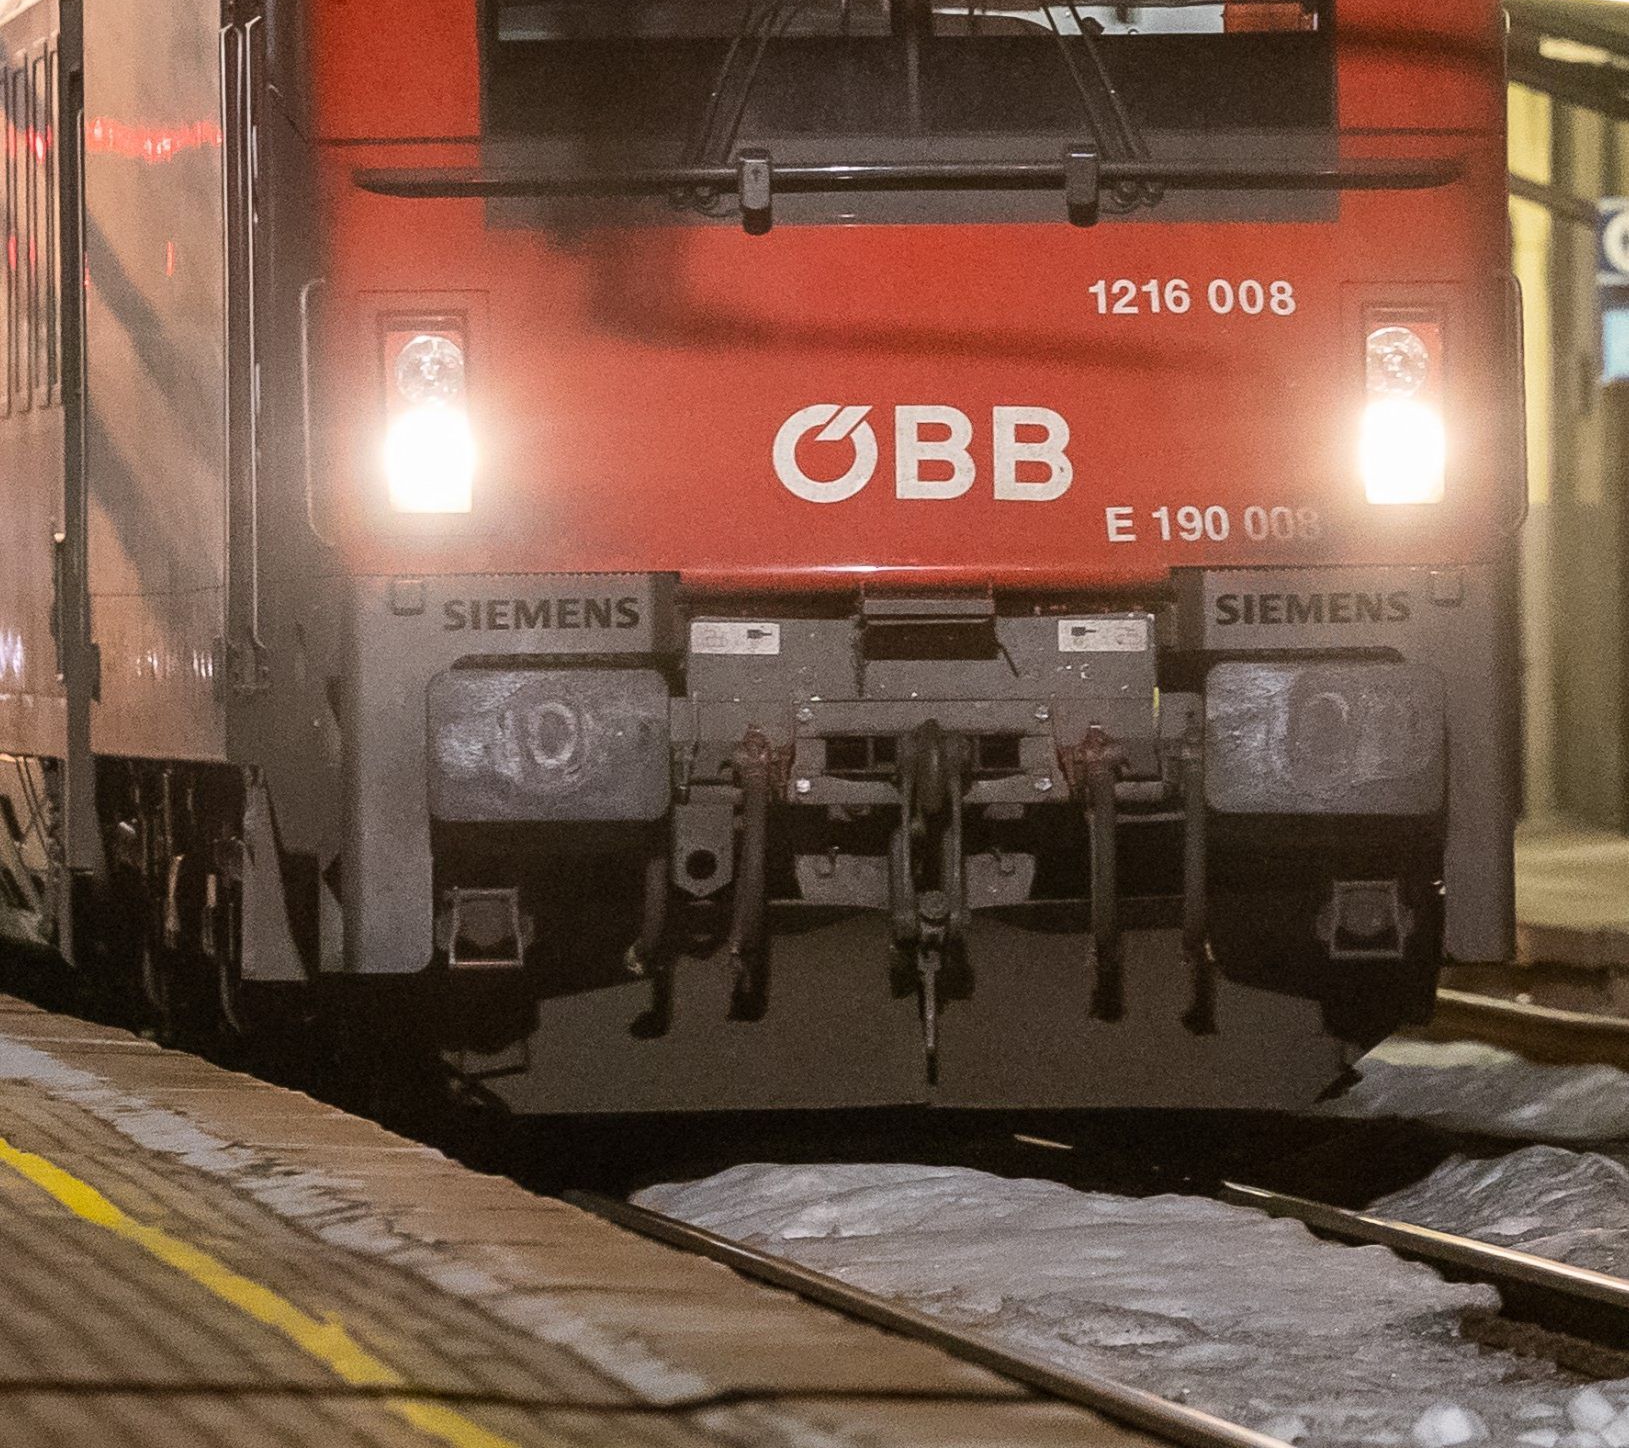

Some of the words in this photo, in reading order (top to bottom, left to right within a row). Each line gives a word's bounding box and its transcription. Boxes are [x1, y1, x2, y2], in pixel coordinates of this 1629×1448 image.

[1088, 278, 1191, 314] 1216
[1207, 278, 1297, 316] 008
[772, 403, 1074, 504] ÖBB
[1104, 505, 1137, 542] E
[1151, 504, 1231, 542] 190
[443, 597, 641, 631] SIEMENS
[1215, 591, 1411, 626] SIEMENS
